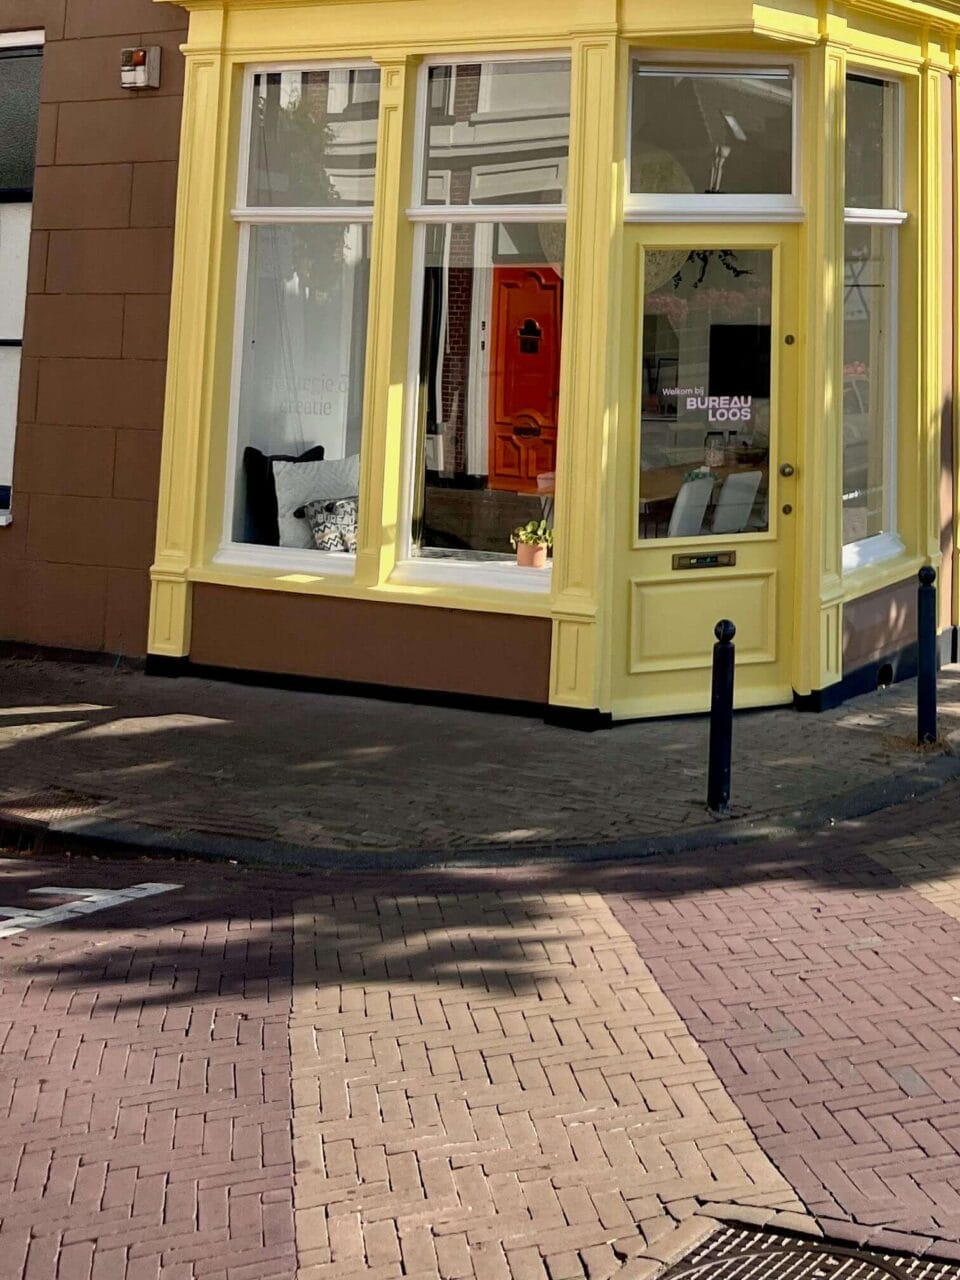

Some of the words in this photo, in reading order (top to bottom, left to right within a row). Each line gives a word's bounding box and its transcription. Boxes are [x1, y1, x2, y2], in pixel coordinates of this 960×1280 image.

[694, 386, 704, 397] bij
[686, 395, 752, 410] BUREAU
[708, 407, 752, 421] LOOS
